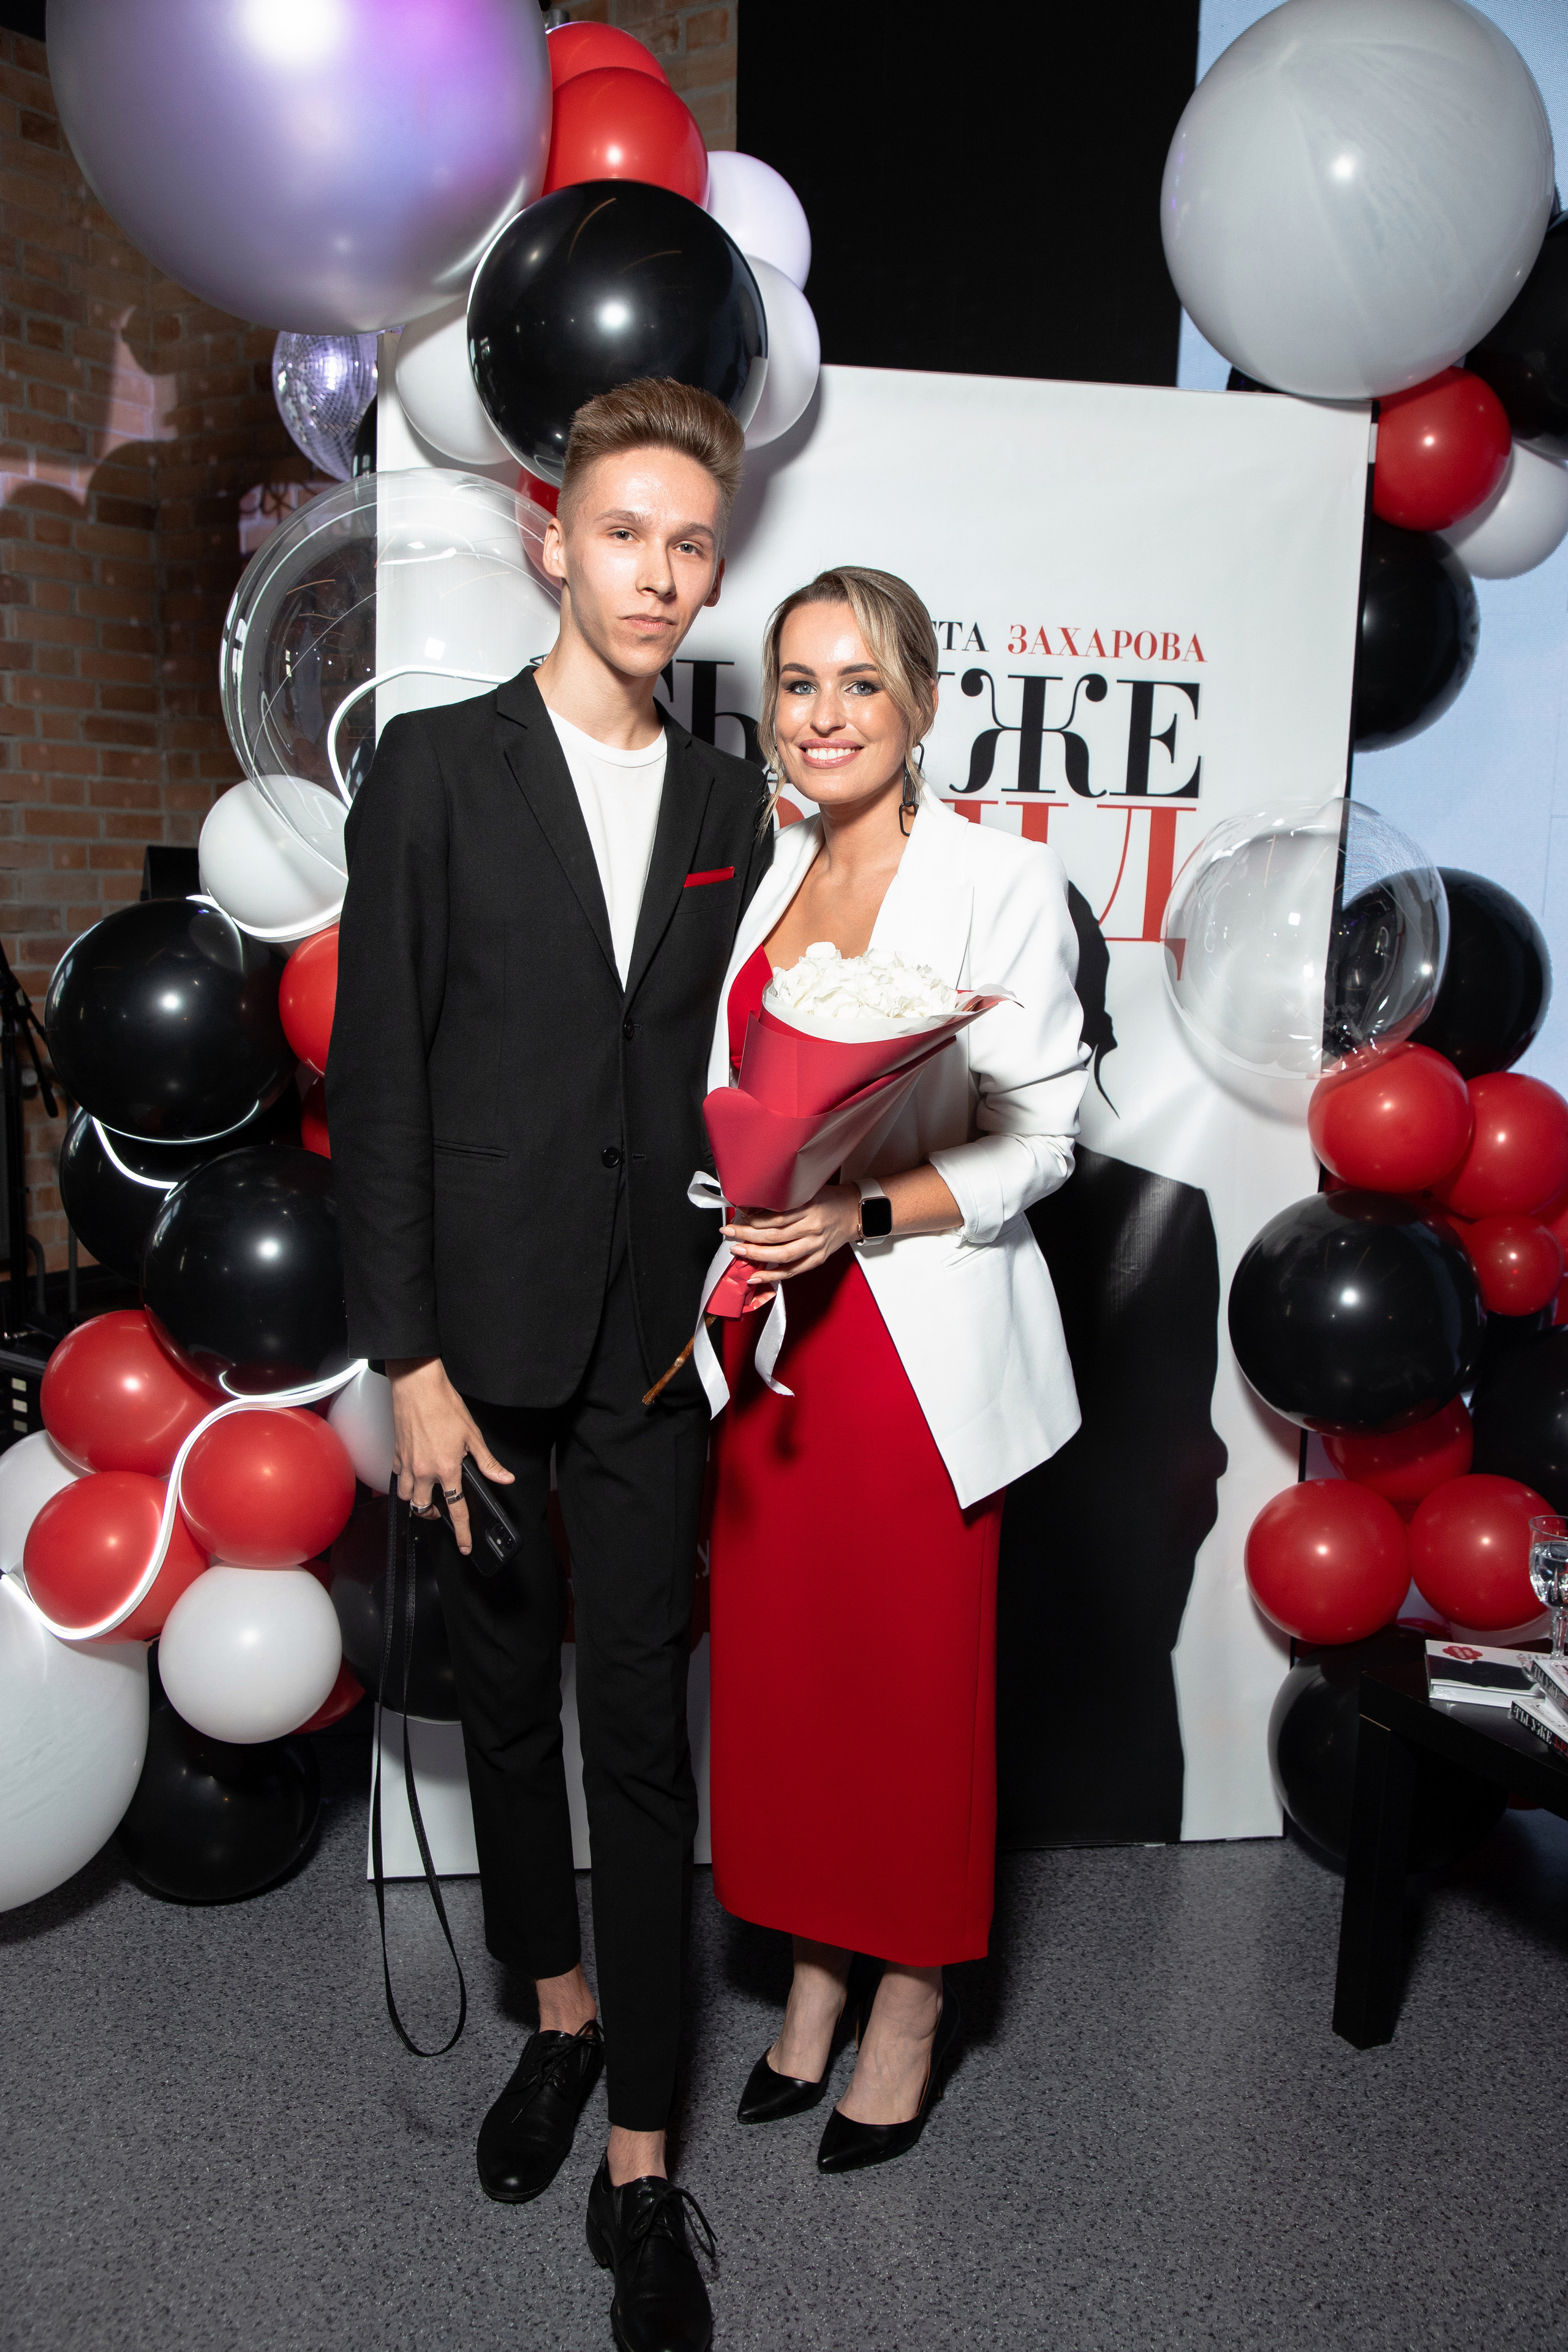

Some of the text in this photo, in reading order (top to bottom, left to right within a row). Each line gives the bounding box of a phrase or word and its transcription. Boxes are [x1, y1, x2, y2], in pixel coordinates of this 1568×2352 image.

[1007, 624, 1208, 663] ЗАХАРОВА
[937, 667, 1204, 799] ЖЕ
[1513, 1705, 1529, 1727] ТЫ
[1529, 1716, 1553, 1745] УЖЕ
